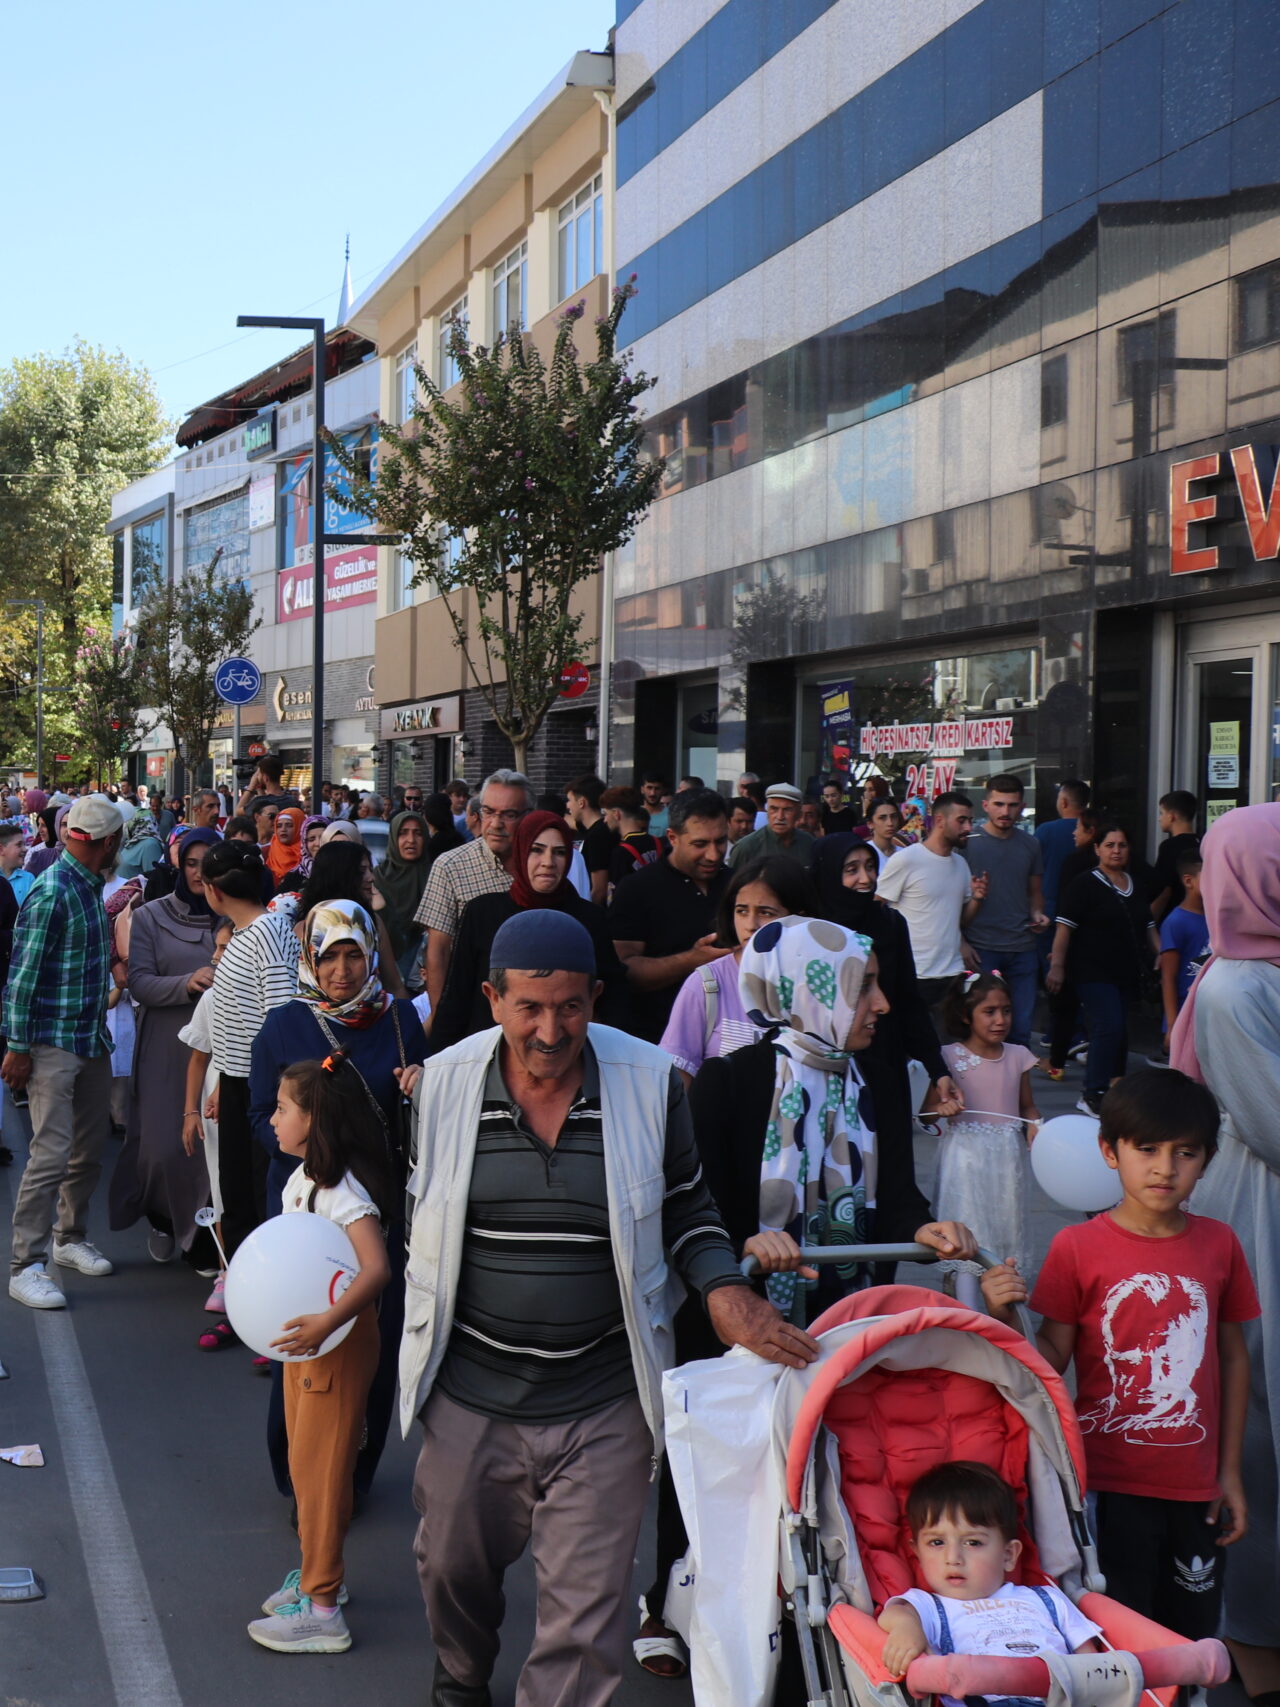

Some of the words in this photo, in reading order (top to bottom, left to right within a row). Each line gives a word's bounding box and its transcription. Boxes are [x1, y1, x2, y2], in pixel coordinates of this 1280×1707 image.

[1170, 444, 1280, 576] EV
[966, 720, 1012, 749] KARTSIZ
[1173, 1575, 1216, 1593] adidas
